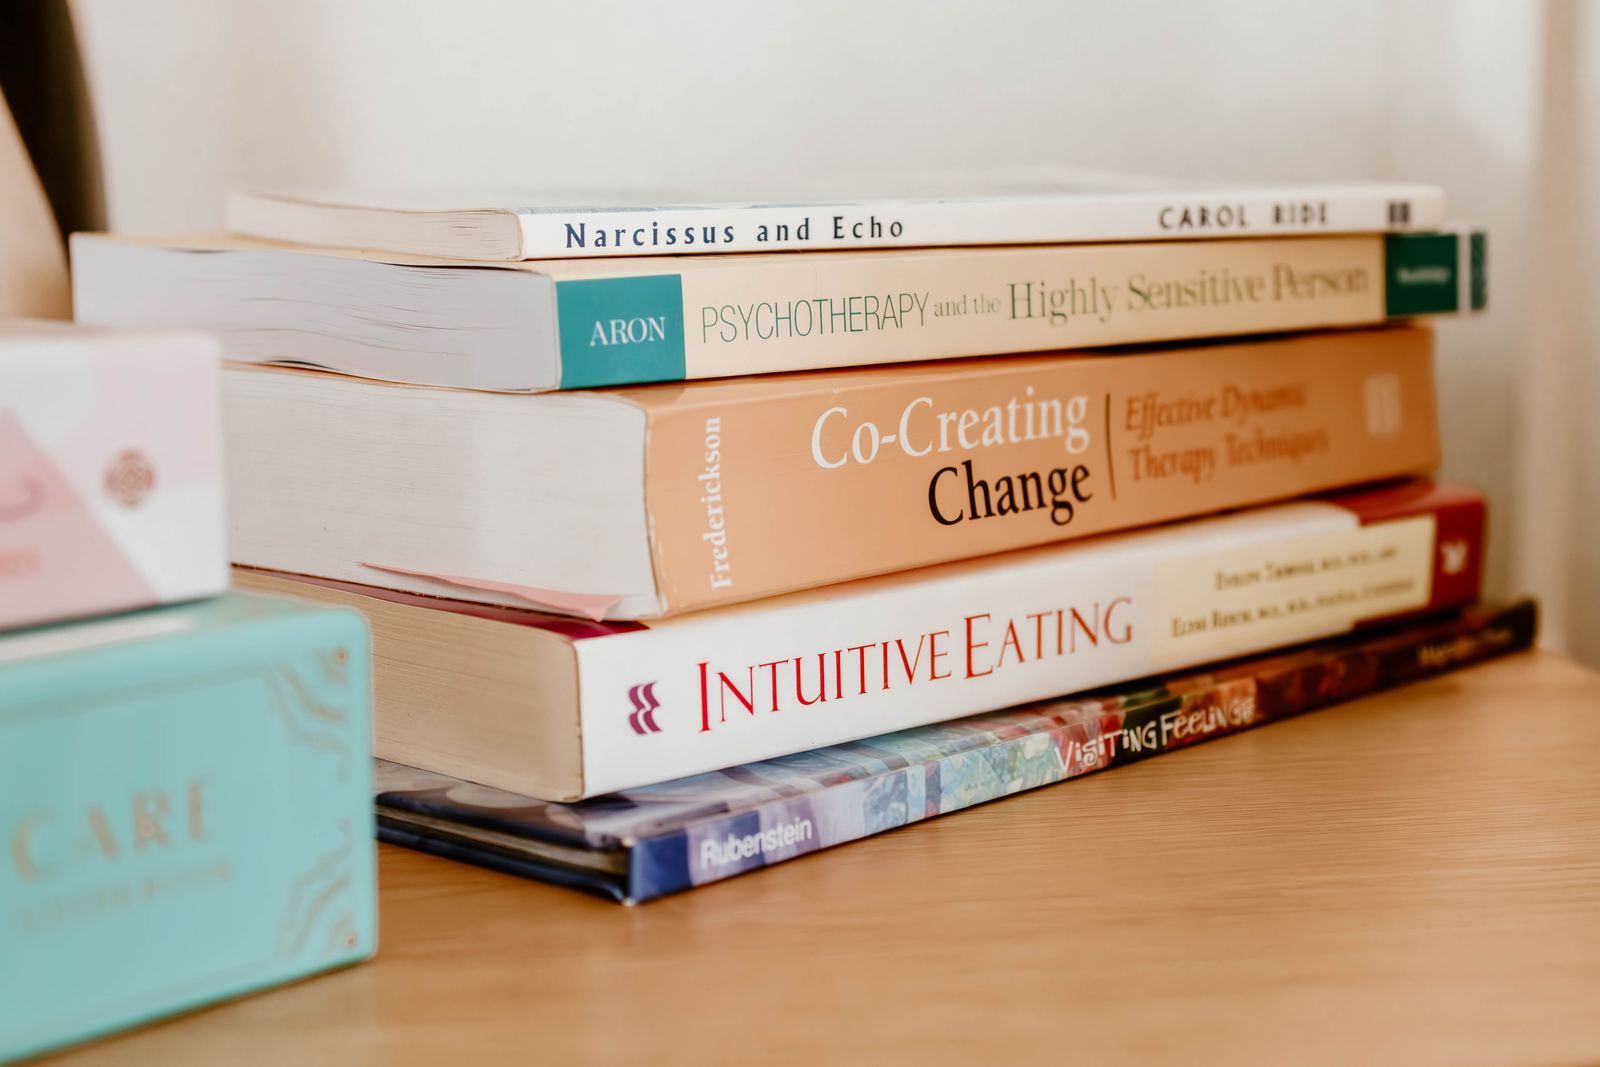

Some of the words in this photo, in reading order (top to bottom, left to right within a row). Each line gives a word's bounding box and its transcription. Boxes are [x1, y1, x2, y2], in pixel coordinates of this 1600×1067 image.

[565, 221, 735, 249] Narcissus
[757, 217, 811, 242] and
[832, 215, 904, 240] Echo
[1159, 205, 1248, 230] CAROL
[702, 292, 929, 344] PSYCHOTHERAPY
[934, 294, 967, 317] and
[973, 293, 1000, 315] the
[1007, 276, 1119, 327] Highly
[1127, 267, 1268, 312] Sensitive
[1271, 263, 1369, 299] Person
[589, 316, 667, 347] ARON
[811, 386, 1090, 470] Co-Creating
[1124, 391, 1215, 439] Effective
[1129, 444, 1217, 484] Therapy
[697, 416, 732, 591] Frederickson
[928, 459, 1093, 526] Change
[697, 630, 952, 732] INTUITIVE
[964, 597, 1134, 680] EATING
[700, 816, 813, 870] Rubenstein
